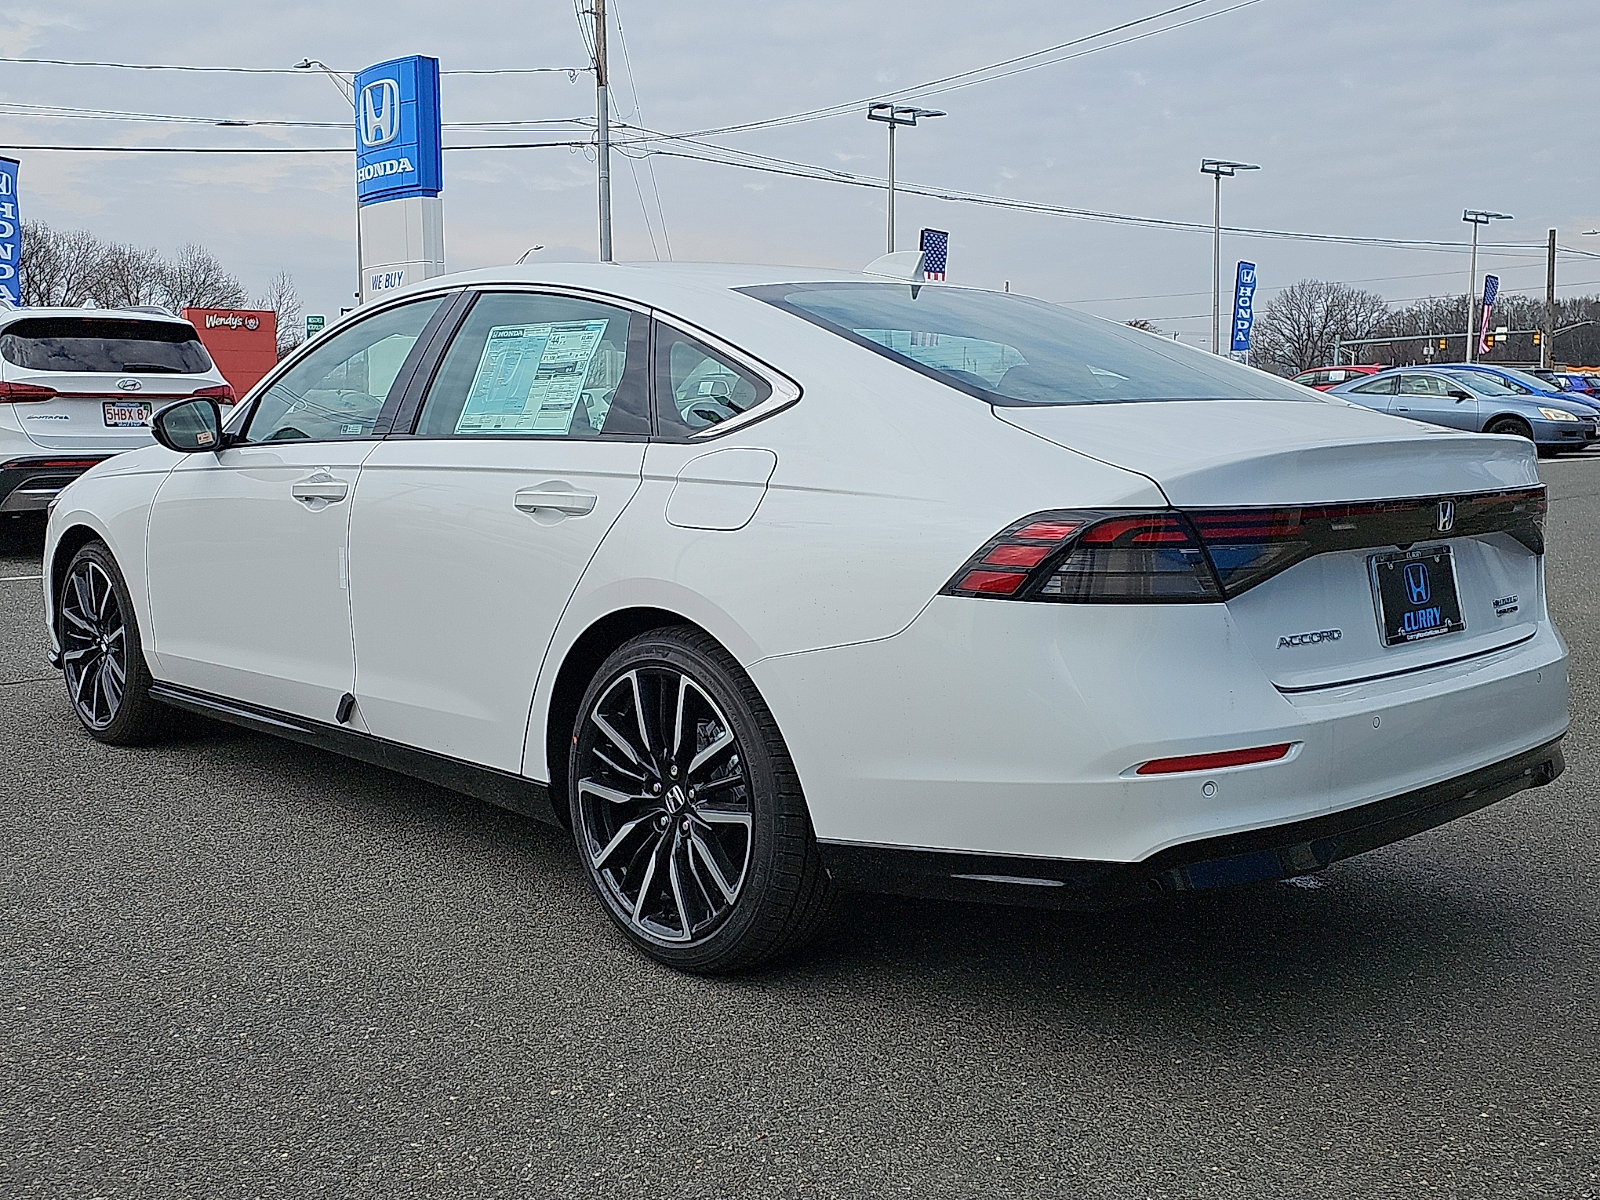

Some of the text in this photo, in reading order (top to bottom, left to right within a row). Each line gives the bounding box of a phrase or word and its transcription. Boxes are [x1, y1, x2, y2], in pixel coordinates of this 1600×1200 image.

[357, 157, 414, 183] HONDA
[371, 270, 404, 290] WE BUY
[205, 312, 243, 330] Wendy's
[1235, 286, 1252, 341] HONDA
[106, 408, 150, 421] 5HBX 87
[1403, 606, 1441, 632] CURRY
[1276, 629, 1342, 649] ACCORD
